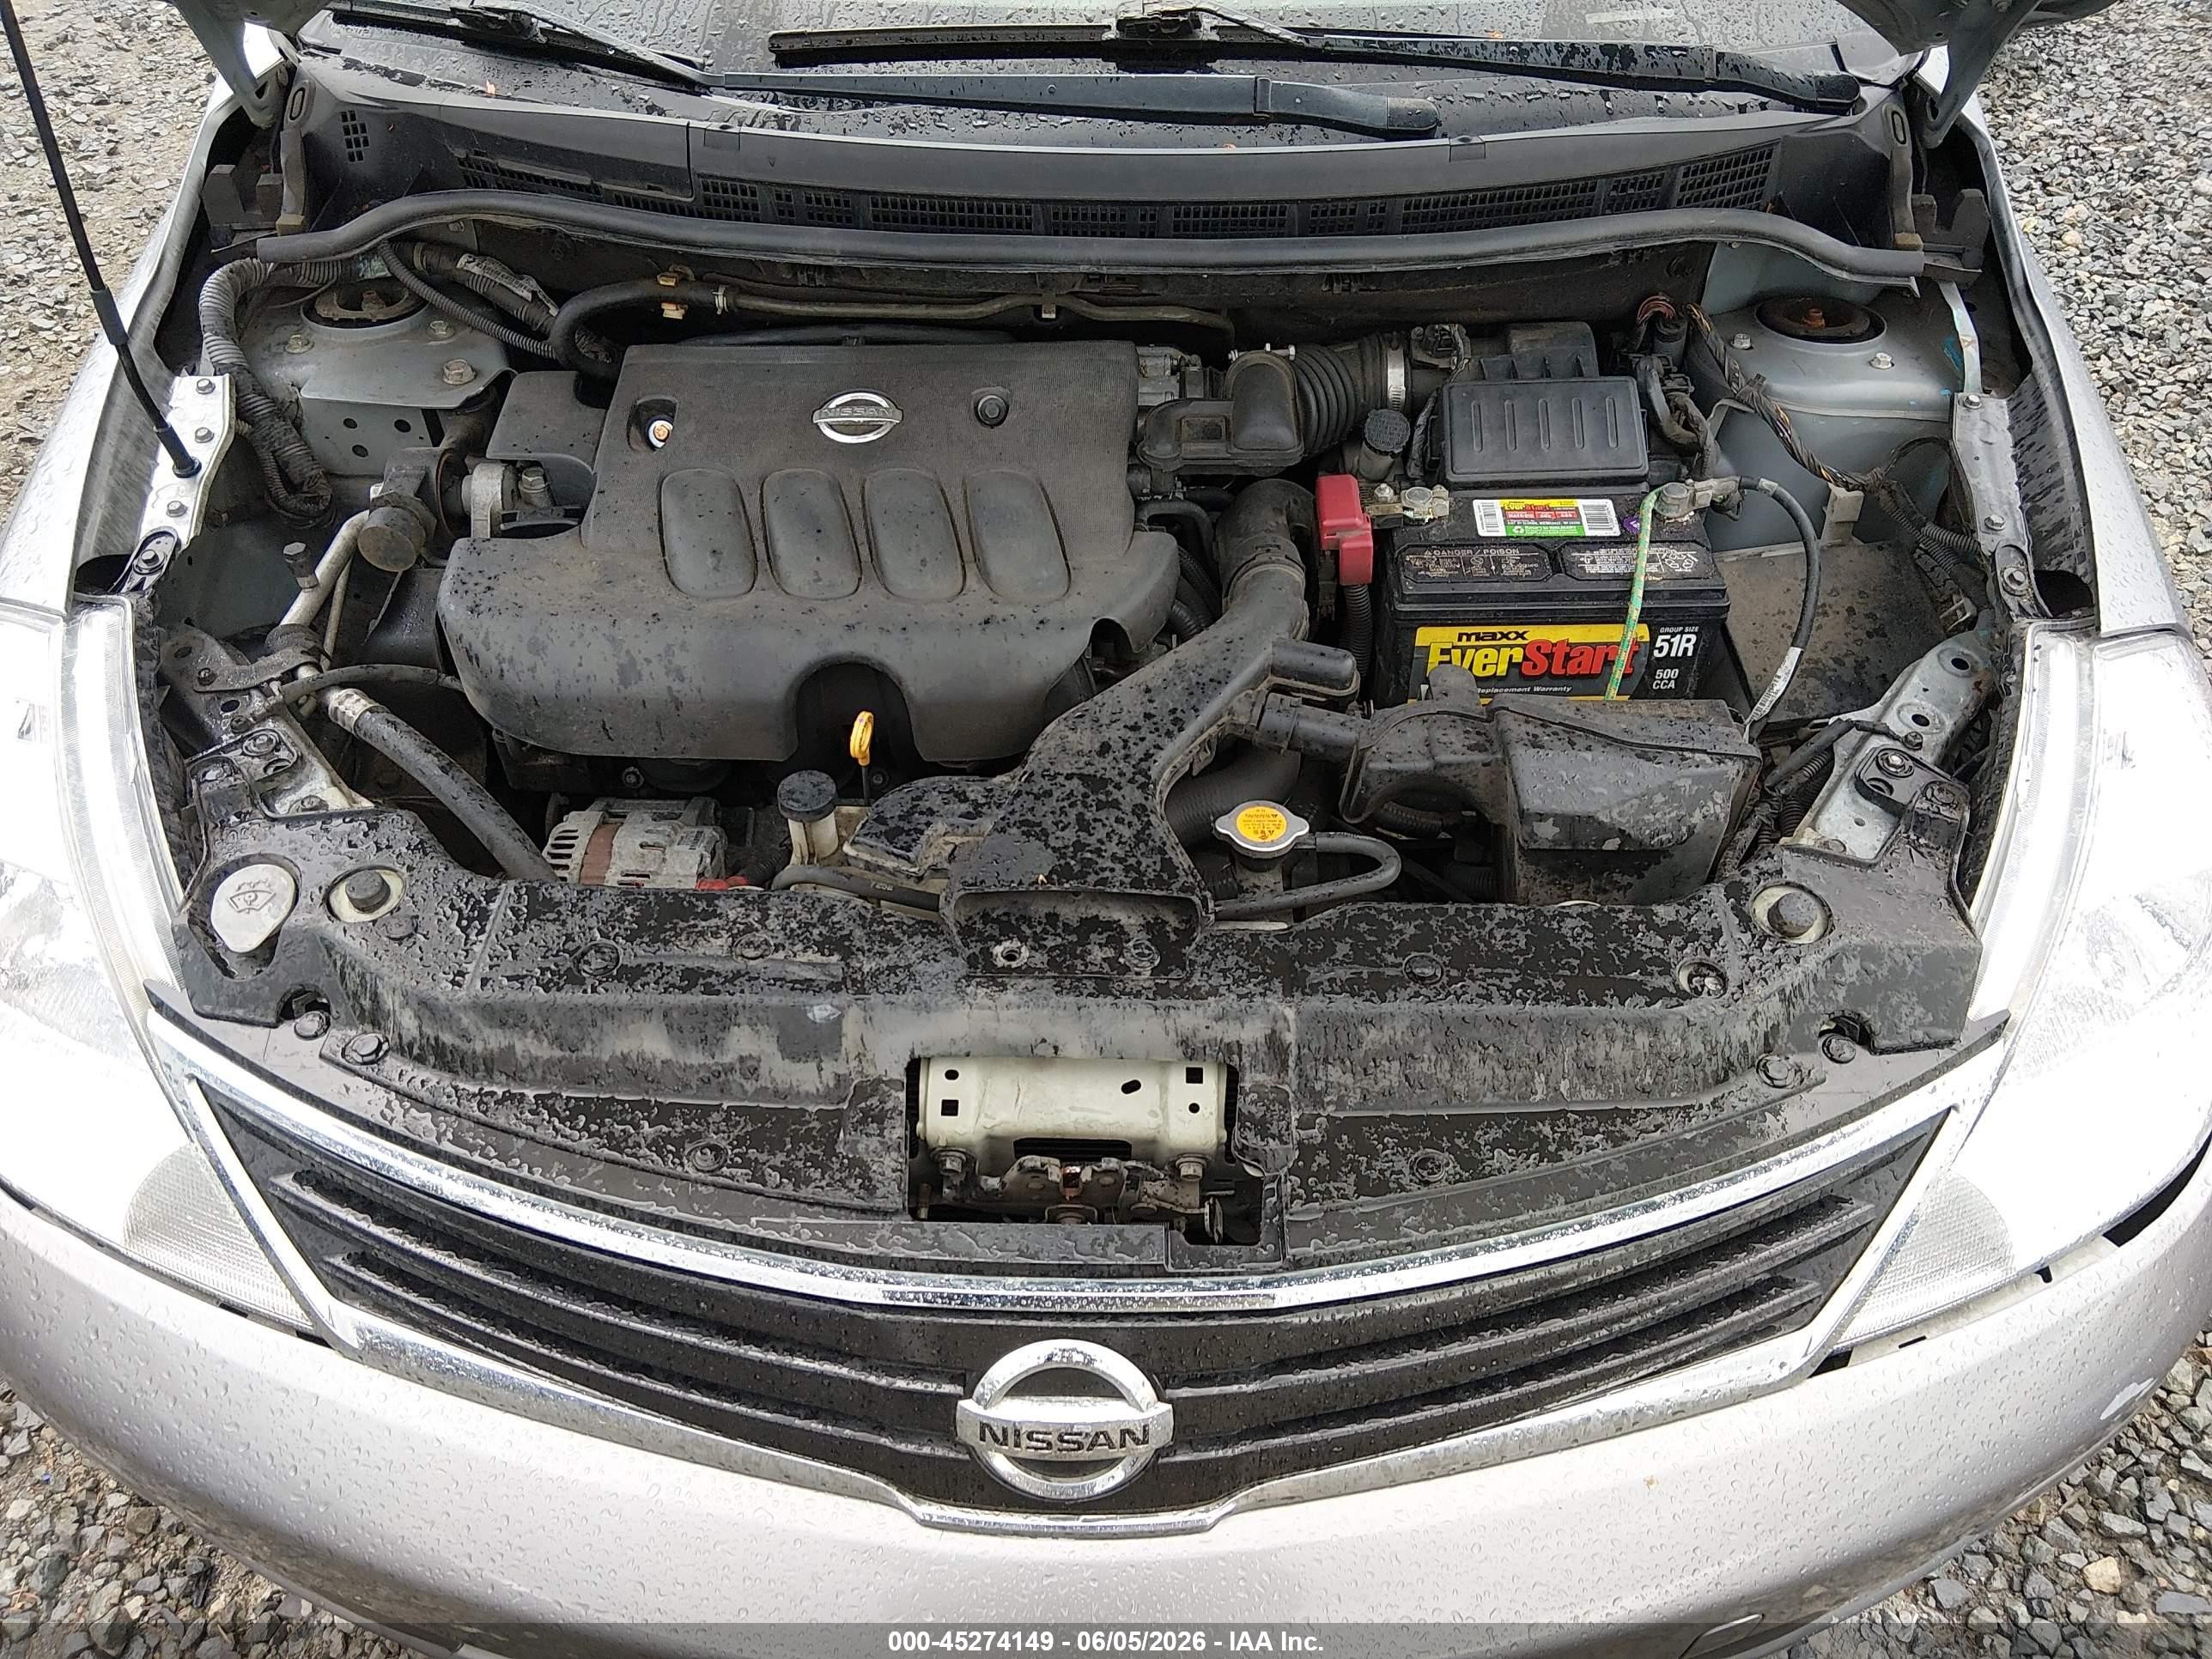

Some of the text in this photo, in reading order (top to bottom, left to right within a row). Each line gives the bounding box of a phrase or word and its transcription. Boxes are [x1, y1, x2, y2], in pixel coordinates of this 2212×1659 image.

[823, 407, 893, 416] NISSAN
[1457, 630, 1530, 642] maxx
[1653, 634, 1697, 658] 51R
[1425, 639, 1639, 678] EverStart
[1655, 668, 1680, 679] 500
[1652, 679, 1675, 690] CCA
[979, 1421, 1150, 1452] NISSAN
